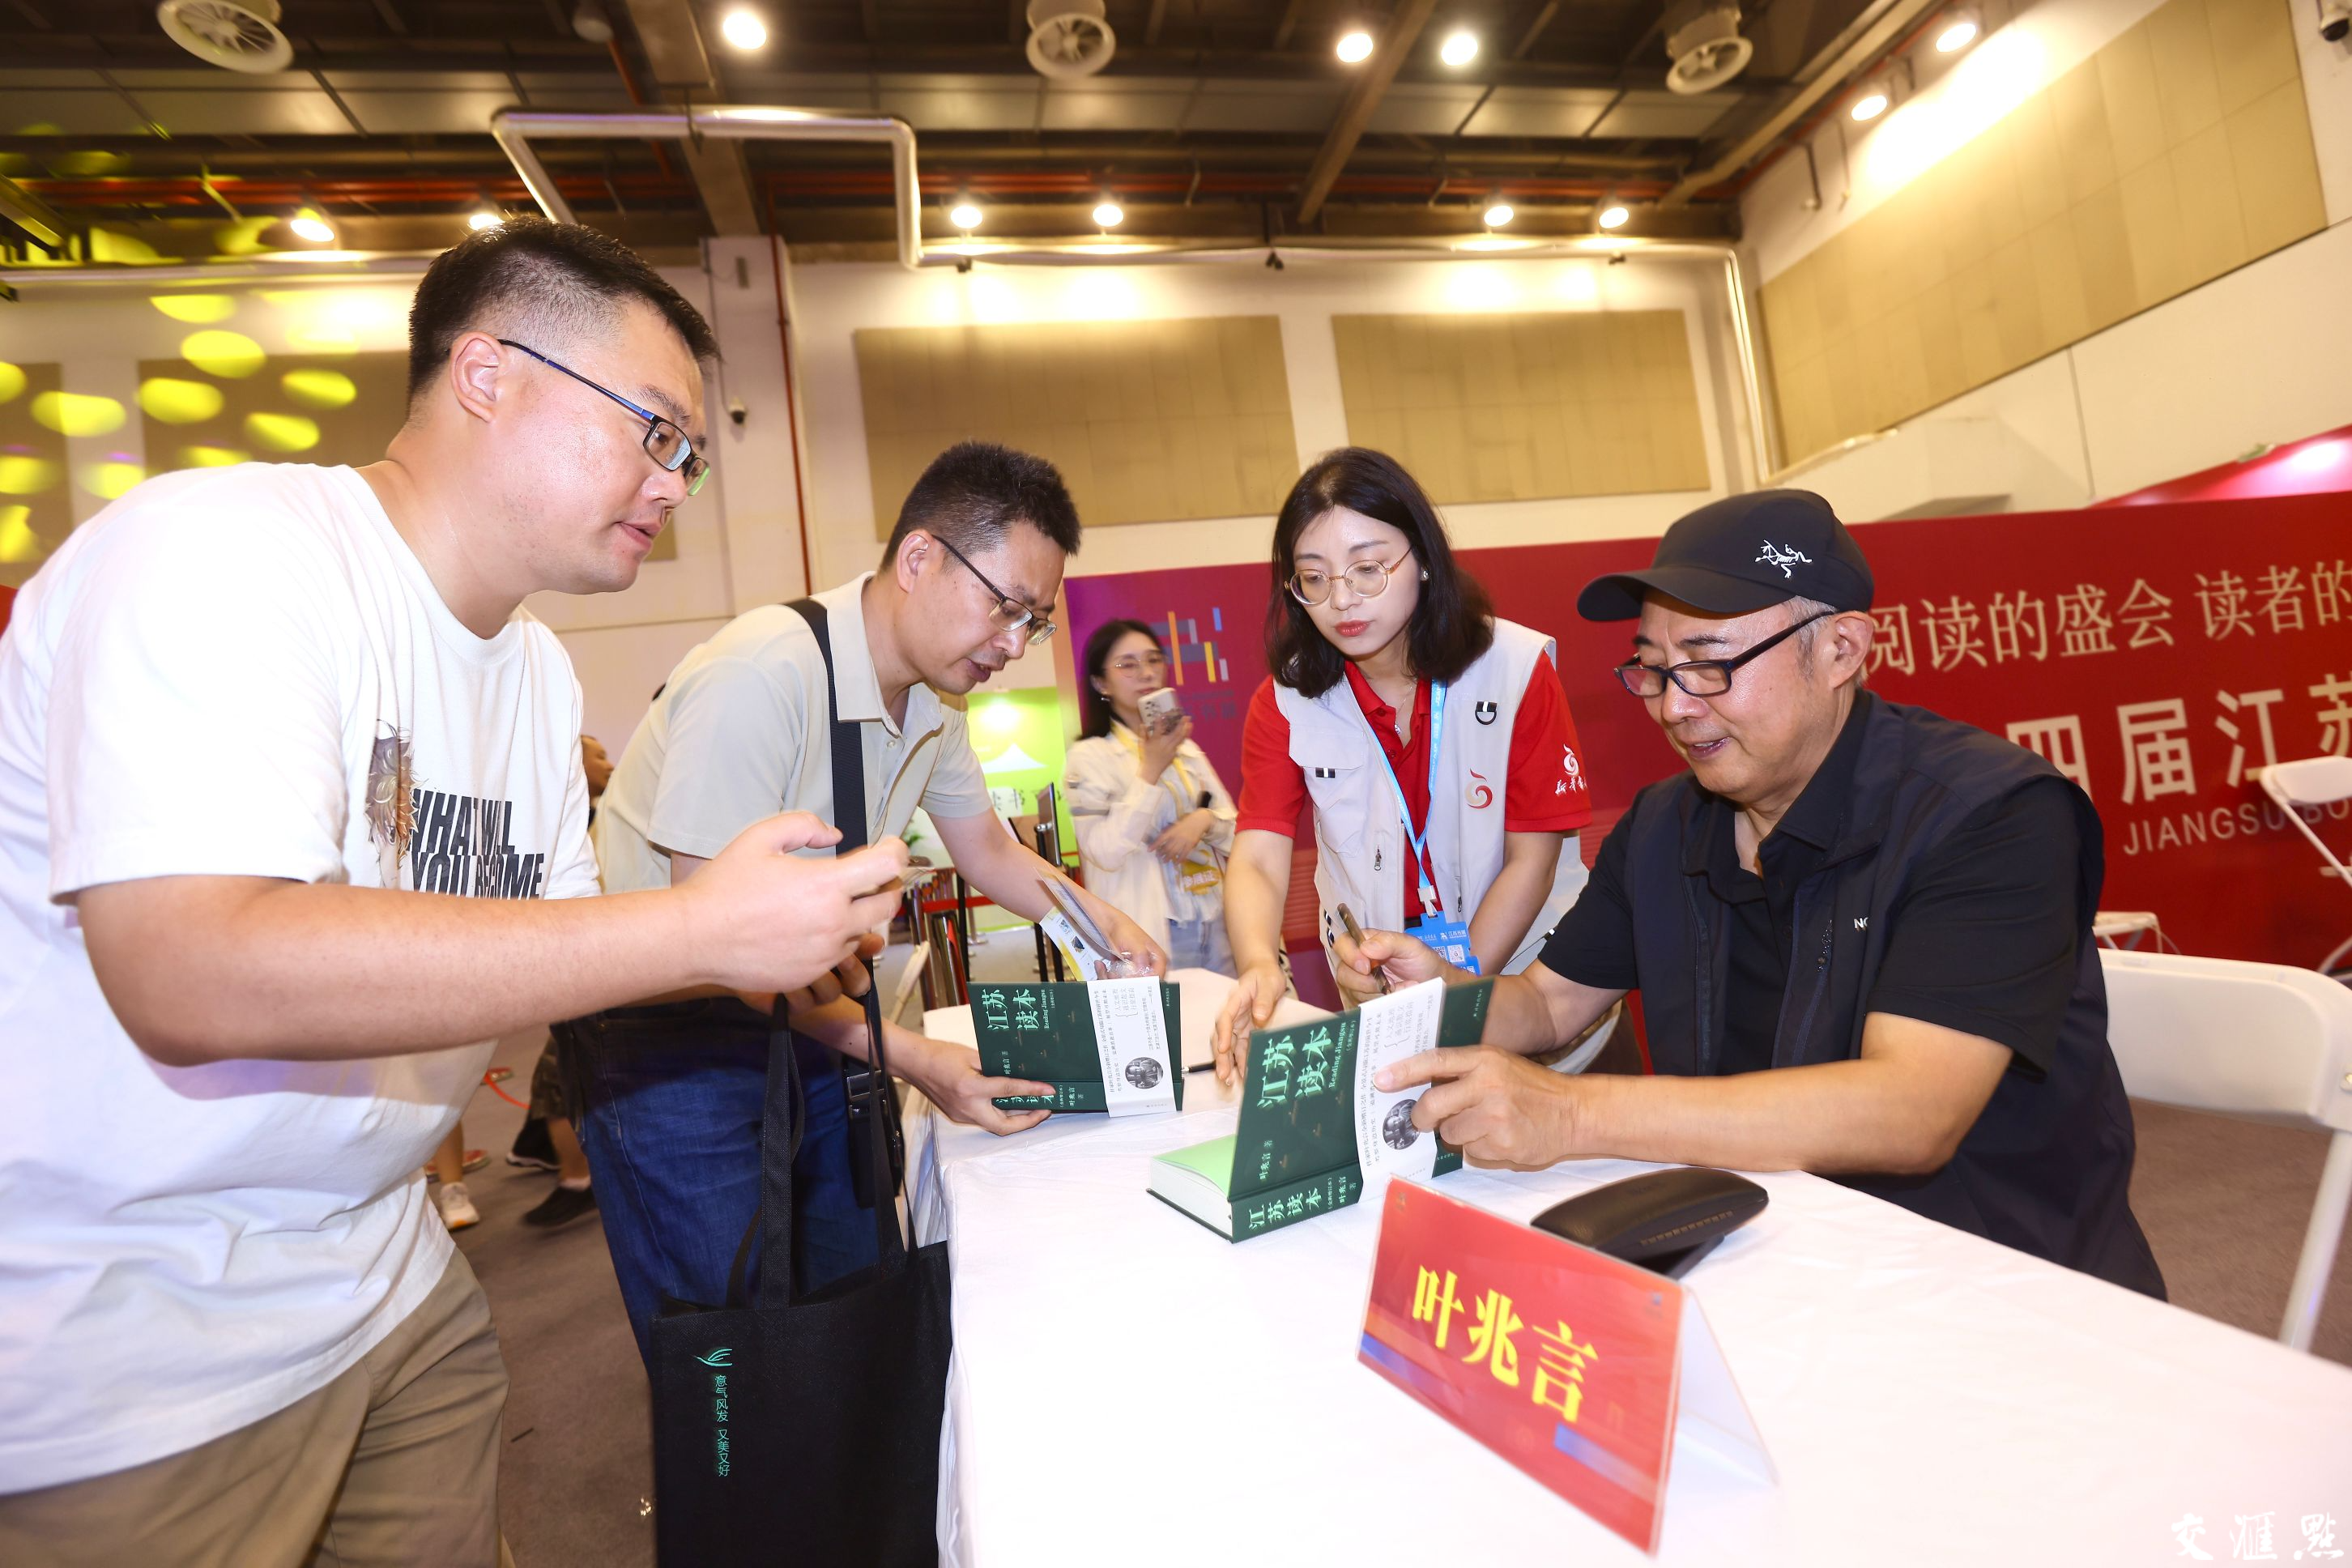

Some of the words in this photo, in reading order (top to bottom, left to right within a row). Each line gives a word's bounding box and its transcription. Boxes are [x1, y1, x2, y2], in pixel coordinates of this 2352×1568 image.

[1864, 577, 2175, 676] 阅读的盛会
[2194, 560, 2352, 640] 读者的
[2123, 802, 2286, 855] JIANGSU
[982, 989, 1010, 1030] 江苏
[1012, 989, 1040, 1030] 读本
[1257, 1035, 1295, 1109] 江苏
[1296, 1026, 1332, 1098] 读本
[1328, 1056, 1340, 1089] Reading
[1335, 1022, 1346, 1056] Jiangsu
[1259, 1153, 1272, 1180] 叶兆言
[1339, 1176, 1347, 1204] 叶兆言
[1249, 1187, 1322, 1230] 江苏读本
[1412, 1265, 1599, 1422] 叶兆言
[715, 1375, 728, 1423] 意气风发
[718, 1429, 730, 1477] 又美又好
